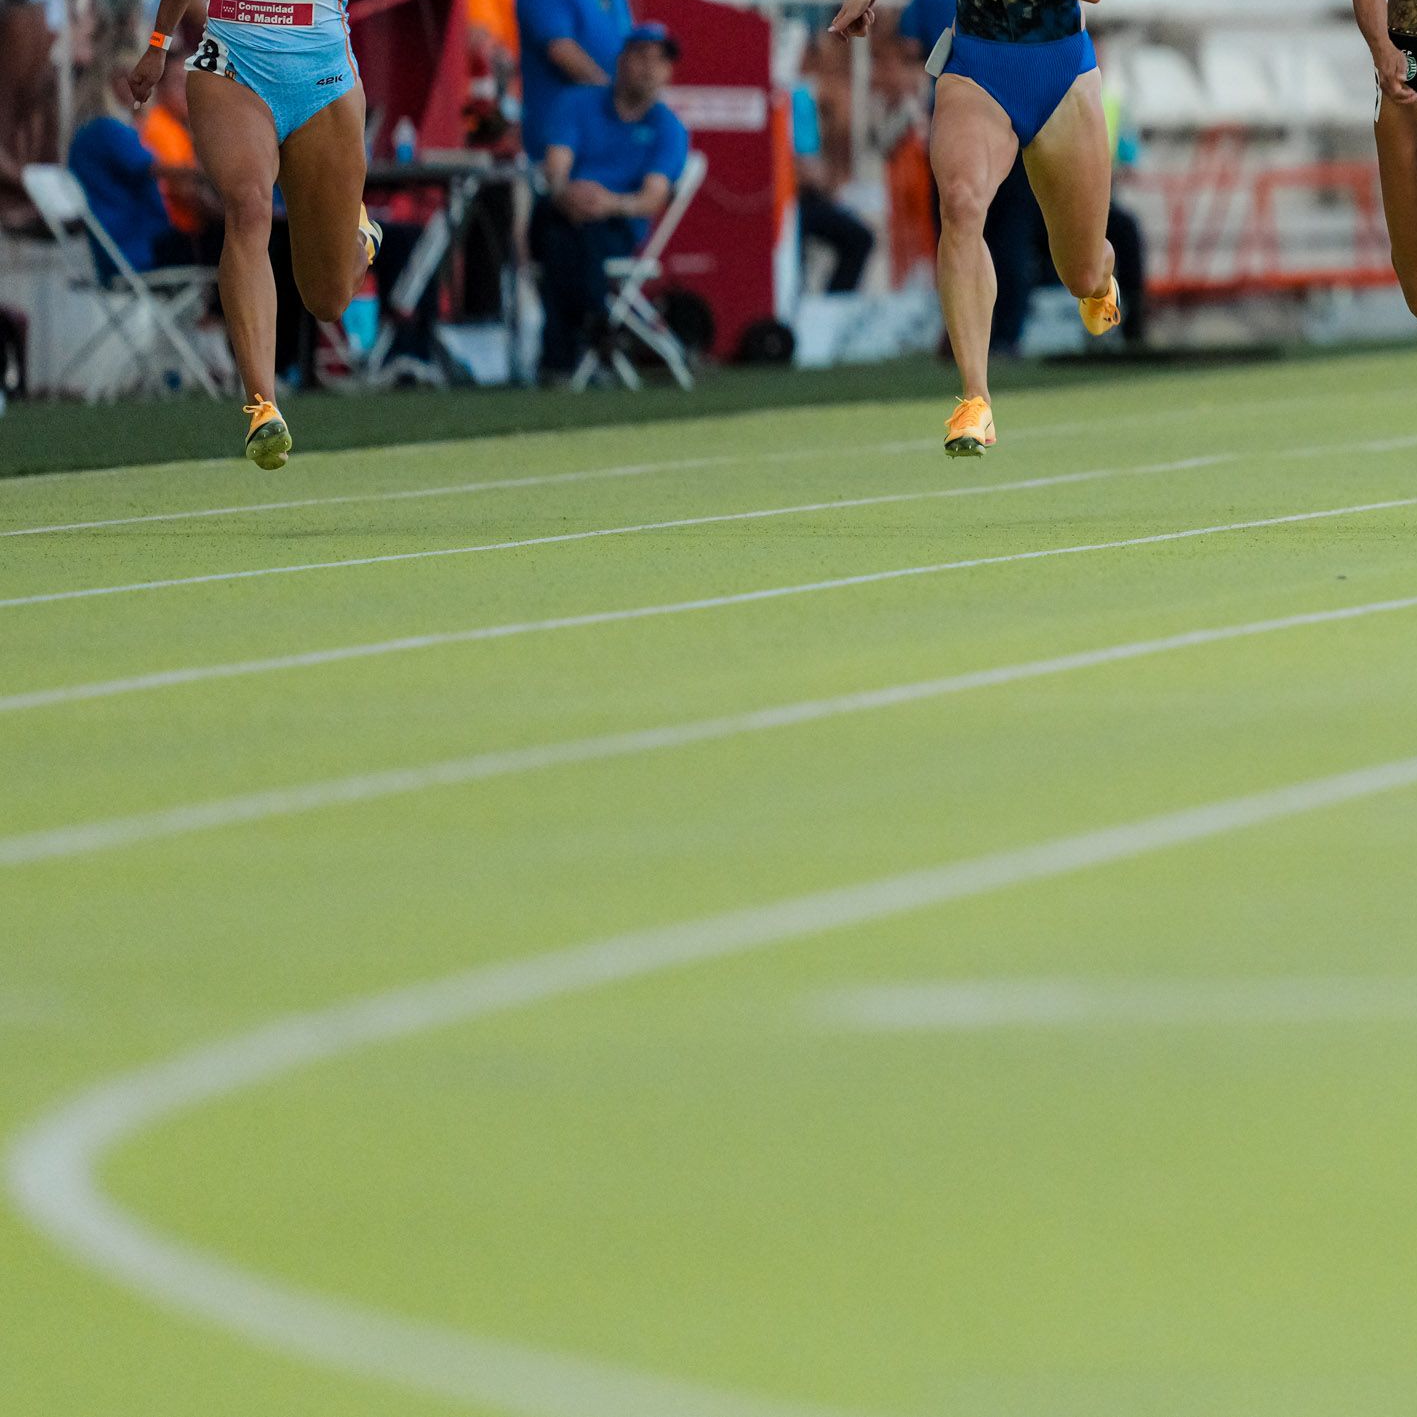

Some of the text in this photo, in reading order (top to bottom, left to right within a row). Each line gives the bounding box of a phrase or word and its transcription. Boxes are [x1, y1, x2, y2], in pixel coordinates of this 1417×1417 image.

[238, 1, 295, 15] Comunidad
[237, 12, 294, 25] de Madrid
[193, 38, 220, 73] 8
